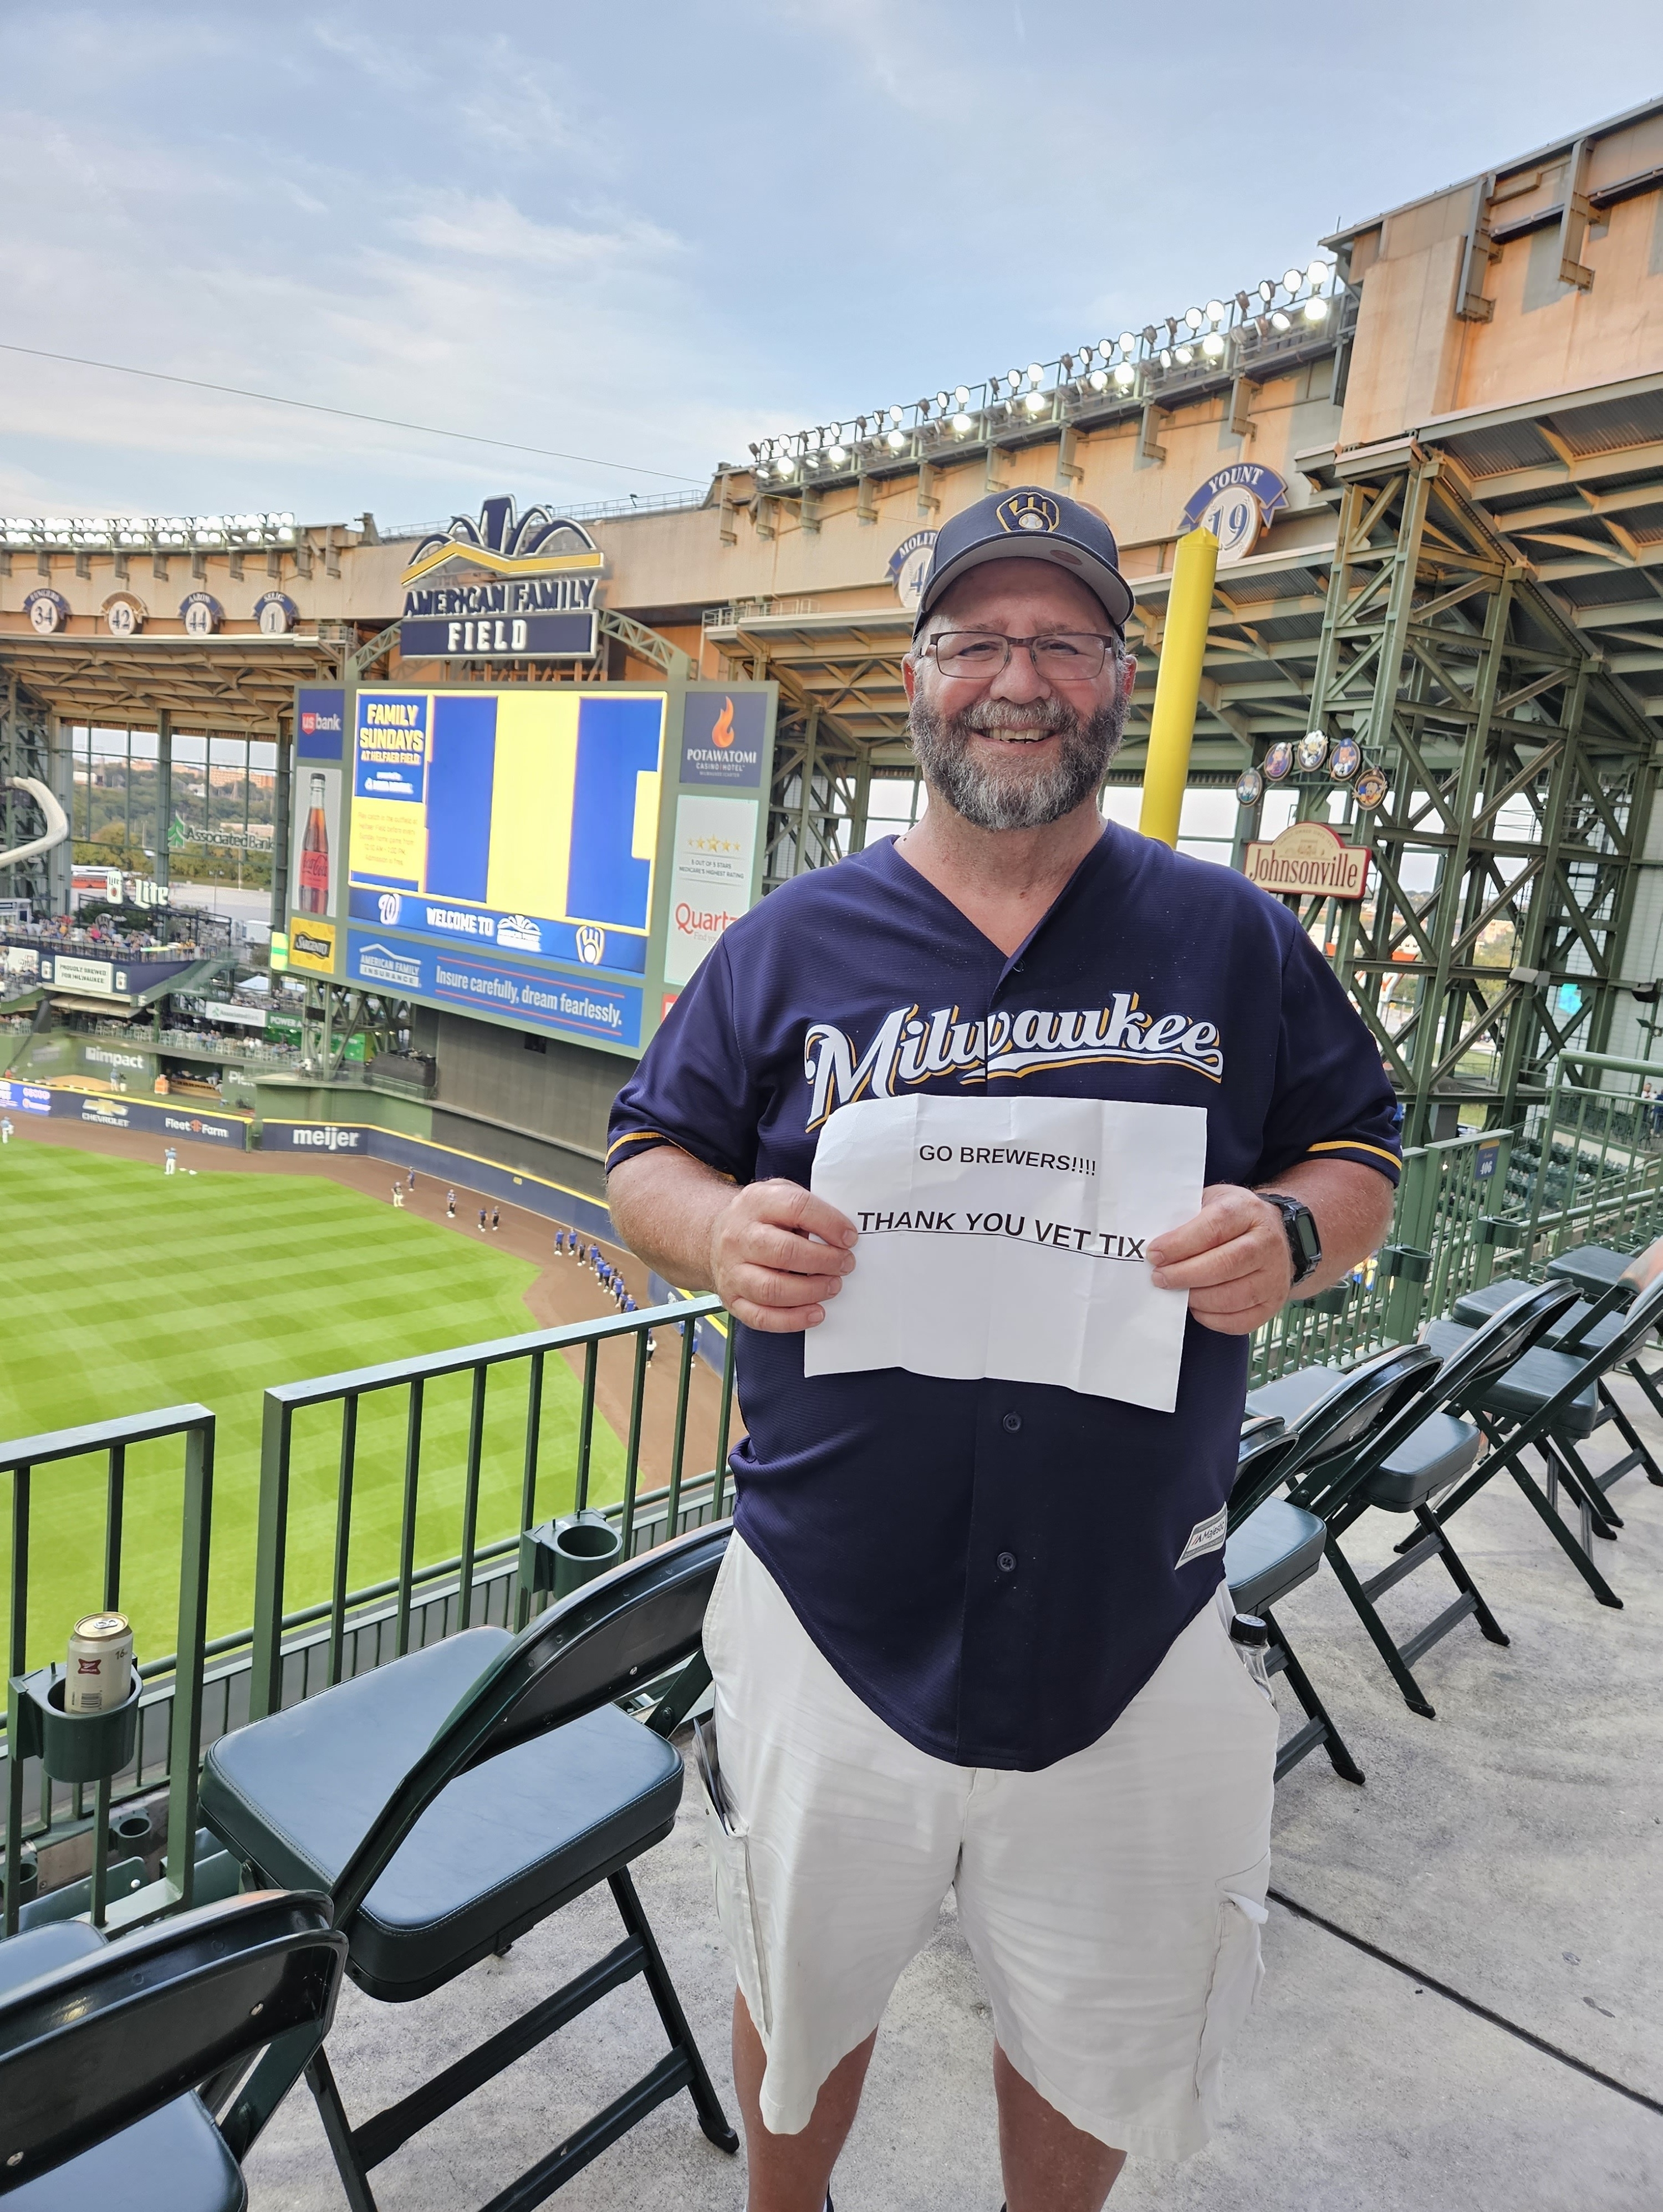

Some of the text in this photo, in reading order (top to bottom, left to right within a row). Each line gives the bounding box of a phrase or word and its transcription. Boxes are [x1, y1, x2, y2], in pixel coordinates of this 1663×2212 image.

[1208, 466, 1264, 495] YOUNT
[1208, 503, 1249, 551] 19
[899, 532, 937, 559] MOLIT
[910, 562, 925, 596] 4
[263, 592, 286, 603] SELIG
[402, 578, 599, 619] AMERICAN FAMILY
[34, 606, 53, 626] 34
[112, 609, 131, 630] 42
[189, 610, 208, 632] 44
[269, 611, 276, 633] 1
[447, 619, 528, 652] FIELD
[367, 704, 419, 727] FAMILY
[360, 727, 424, 752] SUNDAYS
[361, 750, 371, 762] AT
[400, 752, 421, 765] FIELD
[686, 748, 757, 763] POTAWATOMI
[186, 825, 276, 850] Associated Bank
[1249, 848, 1358, 888] Johnsonville
[134, 879, 169, 909] Lite
[426, 907, 494, 936] WELCOME TO
[295, 936, 328, 955] SARGENTO
[693, 931, 707, 941] Find
[60, 964, 83, 972] PROUDLY
[360, 954, 420, 976] AMERICAN FAMILY
[364, 967, 415, 984] INSURANCE
[72, 974, 105, 983] MILWAUKEE
[436, 965, 622, 1028] Insure carefully, dream fearlessly.
[270, 1016, 296, 1027] POWER
[97, 1046, 145, 1069] impact
[805, 992, 1223, 1133] Milwaukee
[81, 1112, 130, 1128] CHEVROLET
[165, 1117, 229, 1138] Fleet Farm
[293, 1126, 360, 1151] meijer
[919, 1144, 1096, 1176] GO BREWERS!!!!
[1480, 1160, 1493, 1175] 406
[856, 1211, 1146, 1260] THANK YOU VET TIX
[115, 1649, 125, 1660] 16
